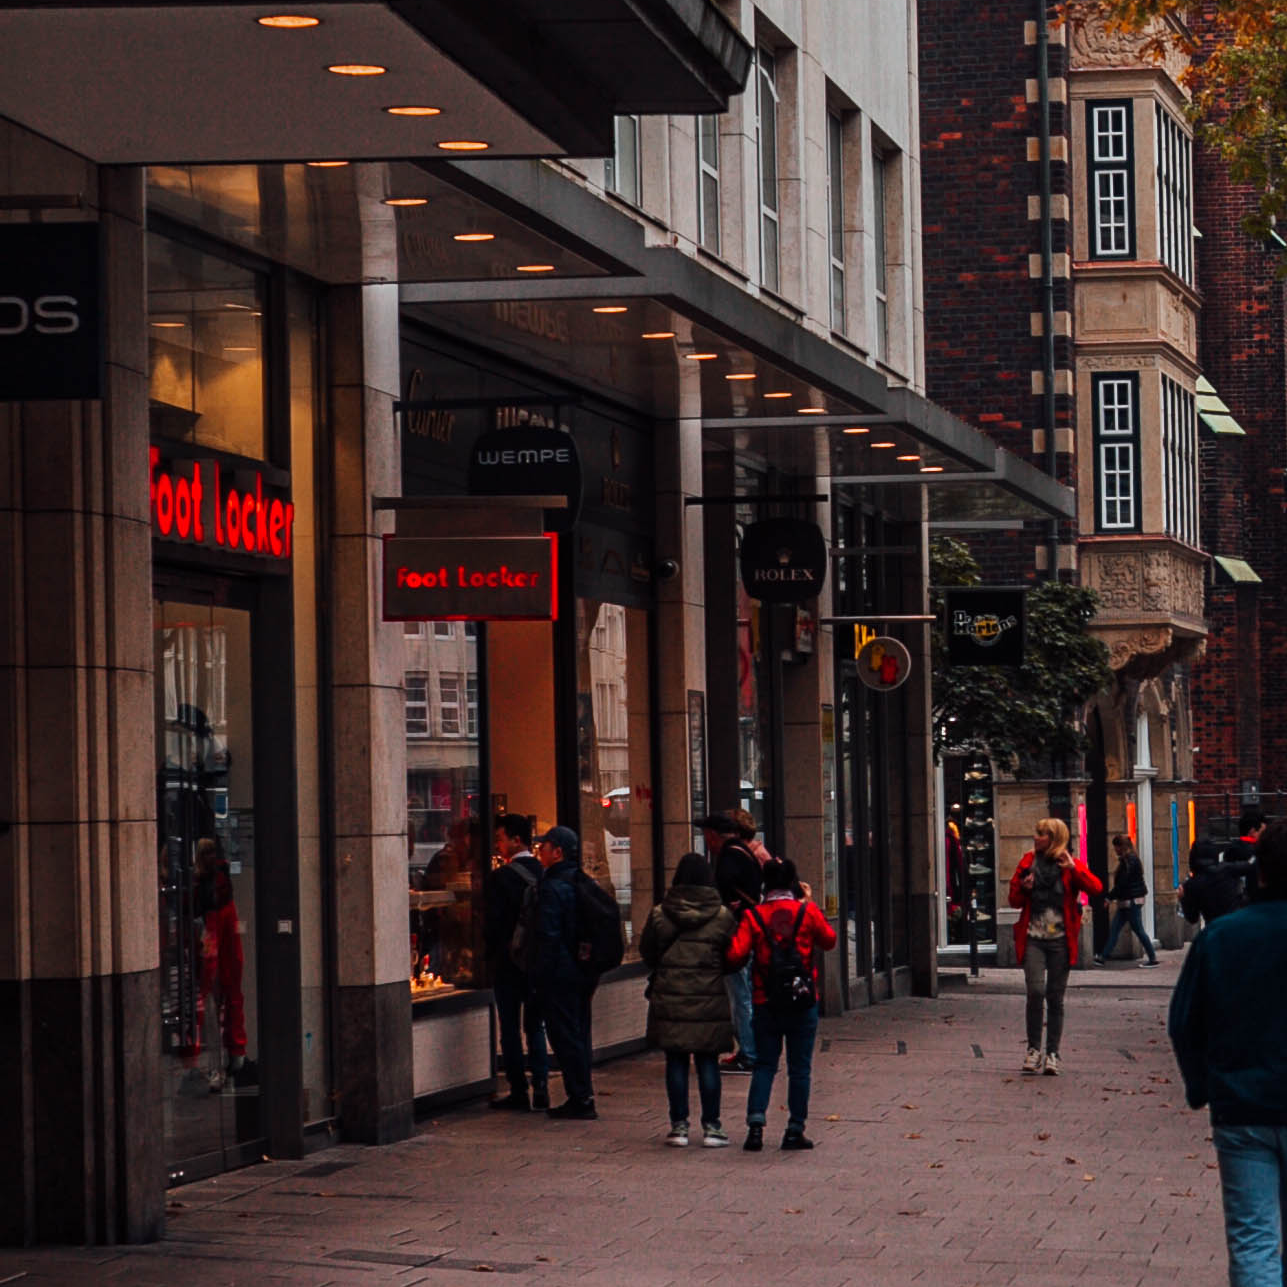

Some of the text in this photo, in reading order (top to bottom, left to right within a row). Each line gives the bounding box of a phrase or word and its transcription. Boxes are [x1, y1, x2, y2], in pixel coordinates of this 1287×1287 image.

[478, 449, 570, 465] WEMPE
[150, 445, 294, 559] Foot Locker
[397, 565, 540, 589] Foot Locker
[754, 568, 816, 582] ROLEX
